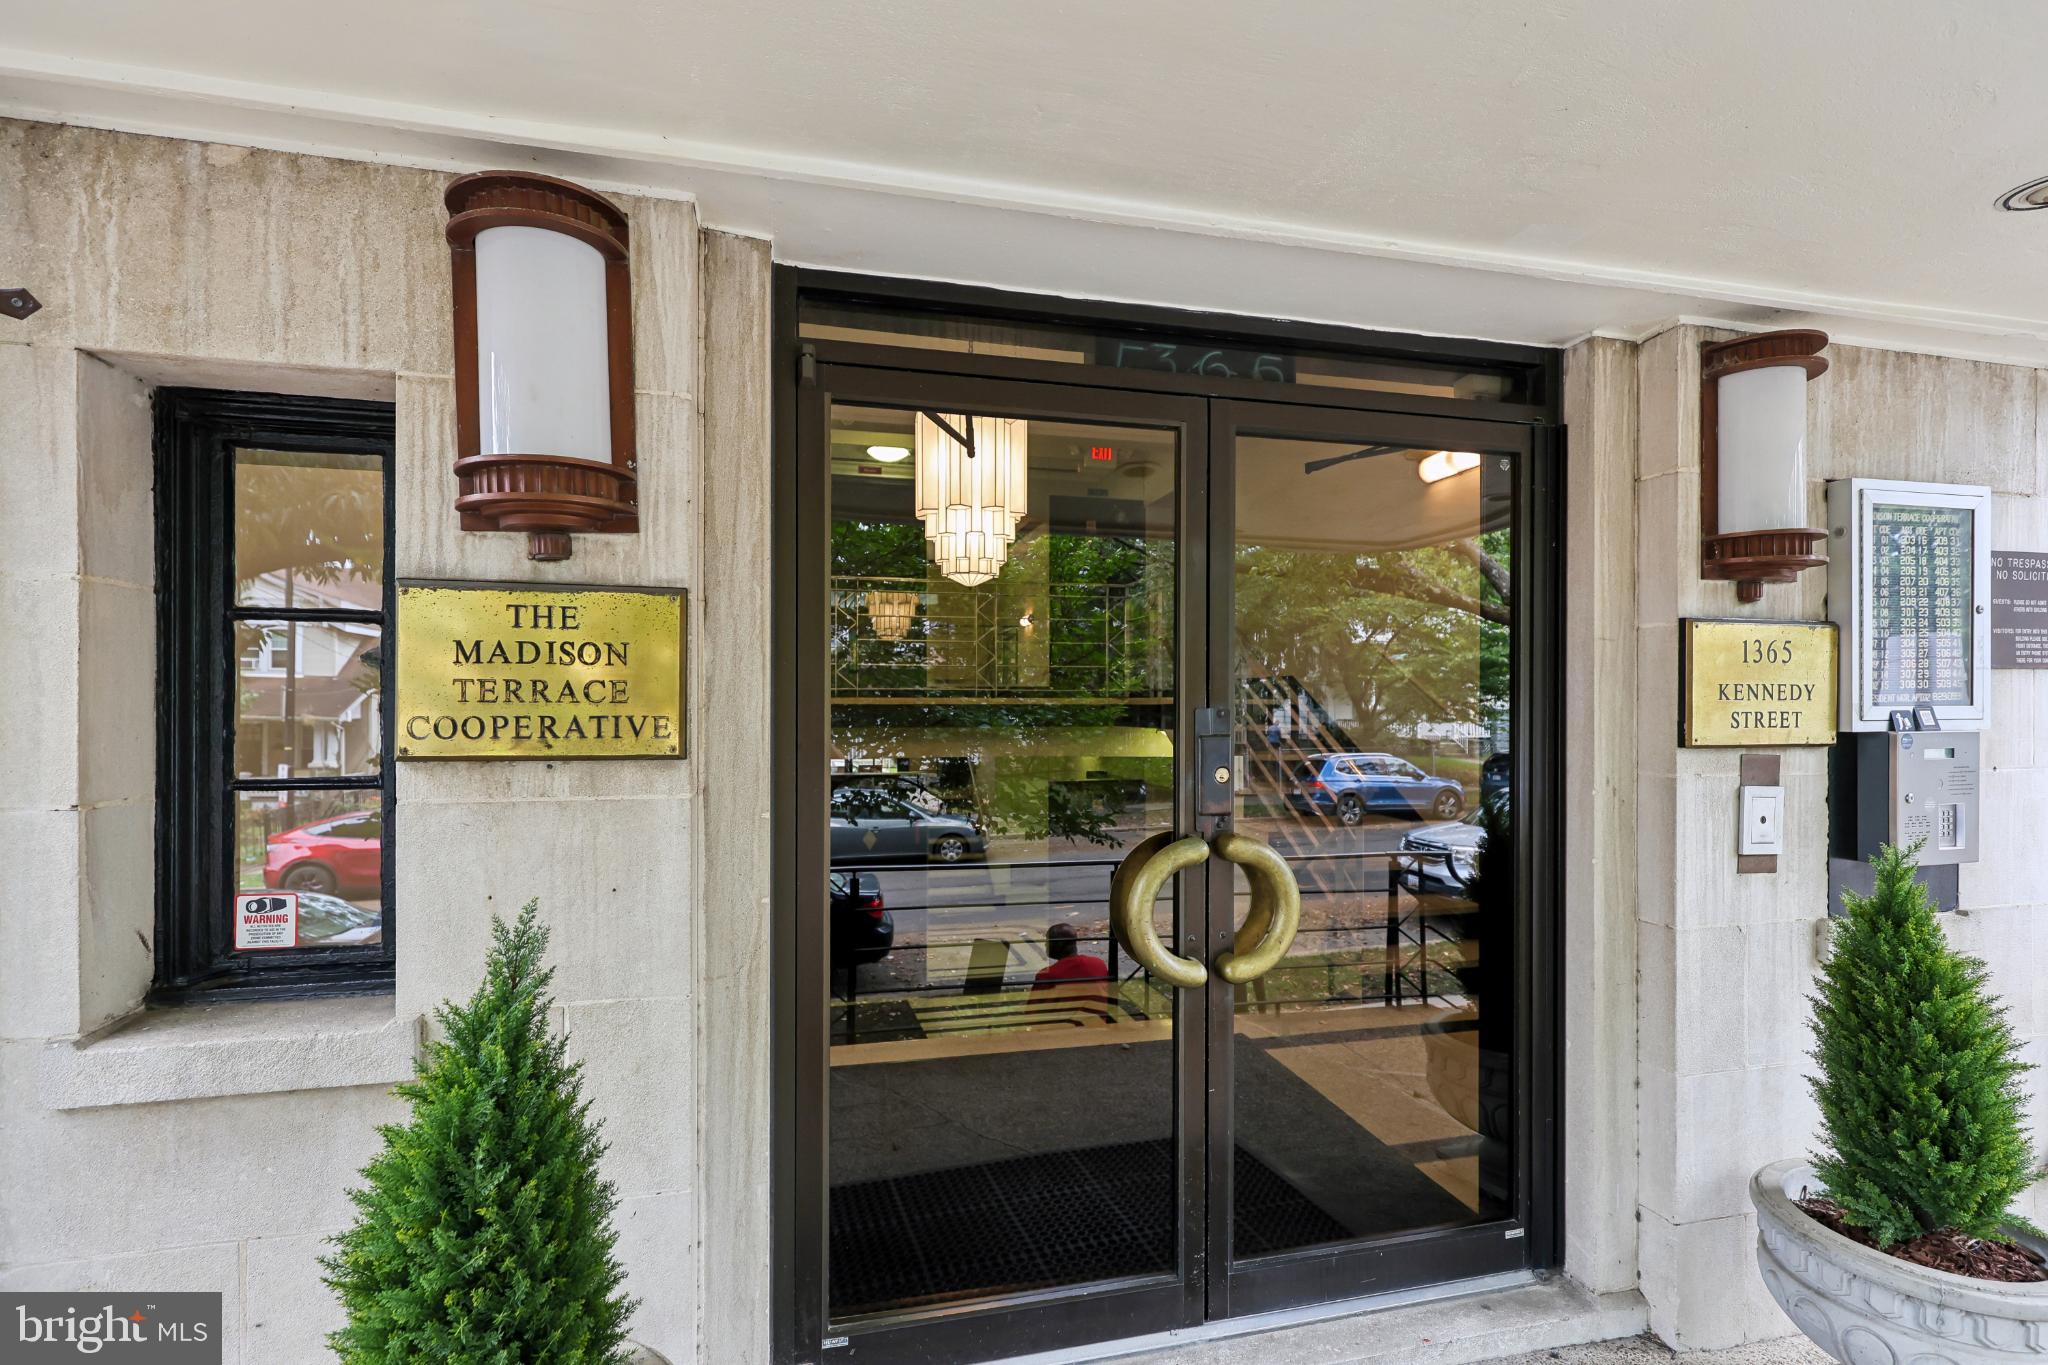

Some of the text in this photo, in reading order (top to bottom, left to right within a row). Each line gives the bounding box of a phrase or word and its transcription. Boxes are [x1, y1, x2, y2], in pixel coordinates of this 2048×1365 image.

[1894, 513, 1920, 522] TERRACE
[1881, 535, 1889, 544] 01
[1918, 536, 1928, 544] 16
[1935, 536, 1949, 545] 309
[1950, 536, 1960, 545] 31
[1881, 546, 1889, 554] 02
[1900, 546, 1916, 555] 204
[1918, 546, 1928, 555] 17
[1935, 547, 1949, 555] 403
[1951, 547, 1960, 555] 32
[1900, 556, 1916, 565] 205
[1918, 556, 1928, 565] 18
[1935, 557, 1949, 565] 404
[1951, 557, 1960, 565] 33
[1992, 558, 2048, 569] NO TRESPAS
[1881, 567, 1889, 575] 04
[1900, 567, 1916, 575] 206
[1918, 567, 1928, 575] 19
[1935, 568, 1949, 576] 405
[1951, 568, 1960, 576] 34
[1997, 570, 2008, 580] NO
[1881, 576, 1889, 585] 05
[1900, 577, 1916, 586] 207
[1918, 577, 1928, 586] 20
[1935, 577, 1949, 586] 406
[1951, 577, 1960, 586] 35
[1881, 587, 1889, 596] 06
[1900, 588, 1916, 596] 208
[1918, 588, 1928, 596] 21
[1935, 588, 1949, 597] 407
[1951, 588, 1960, 597] 36
[1881, 598, 1889, 606] 07
[1900, 597, 1916, 606] 209
[1918, 597, 1928, 606] 22
[1951, 598, 1960, 606] 37
[506, 604, 580, 630] THE
[1881, 608, 1889, 616] 08
[1900, 608, 1916, 616] 301
[1918, 608, 1928, 616] 23
[1936, 608, 1950, 617] 409
[1951, 608, 1960, 617] 38
[1881, 618, 1889, 627] 09
[1900, 618, 1916, 627] 302
[1918, 618, 1928, 627] 24
[1936, 618, 1950, 627] 503
[1881, 628, 1888, 637] 10
[1900, 629, 1916, 637] 303
[1918, 629, 1928, 637] 25
[1936, 629, 1950, 637] 504
[1881, 639, 1888, 647] 11
[1900, 639, 1916, 648] 304
[1918, 639, 1928, 648] 26
[1936, 639, 1950, 648] 505
[1951, 639, 1961, 648] 41
[452, 639, 630, 666] MADISON
[1742, 640, 1792, 664] 1365
[1881, 649, 1888, 658] 12
[1900, 649, 1916, 658] 305
[1918, 649, 1928, 658] 27
[1936, 649, 1950, 658] 506
[1881, 660, 1888, 668] 13
[1900, 660, 1916, 668] 306
[1918, 660, 1928, 668] 28
[1936, 659, 1950, 668] 507
[1900, 670, 1916, 679] 307
[1918, 670, 1928, 679] 29
[1881, 680, 1888, 689] 15
[1900, 680, 1916, 688] 308
[1918, 680, 1928, 688] 30
[1952, 680, 1961, 688] 45
[452, 678, 630, 704] TERRACE
[1718, 684, 1816, 701] KENNEDY
[1730, 711, 1802, 729] STREET
[406, 715, 671, 740] COOPERATIVE
[244, 914, 288, 924] WARNING
